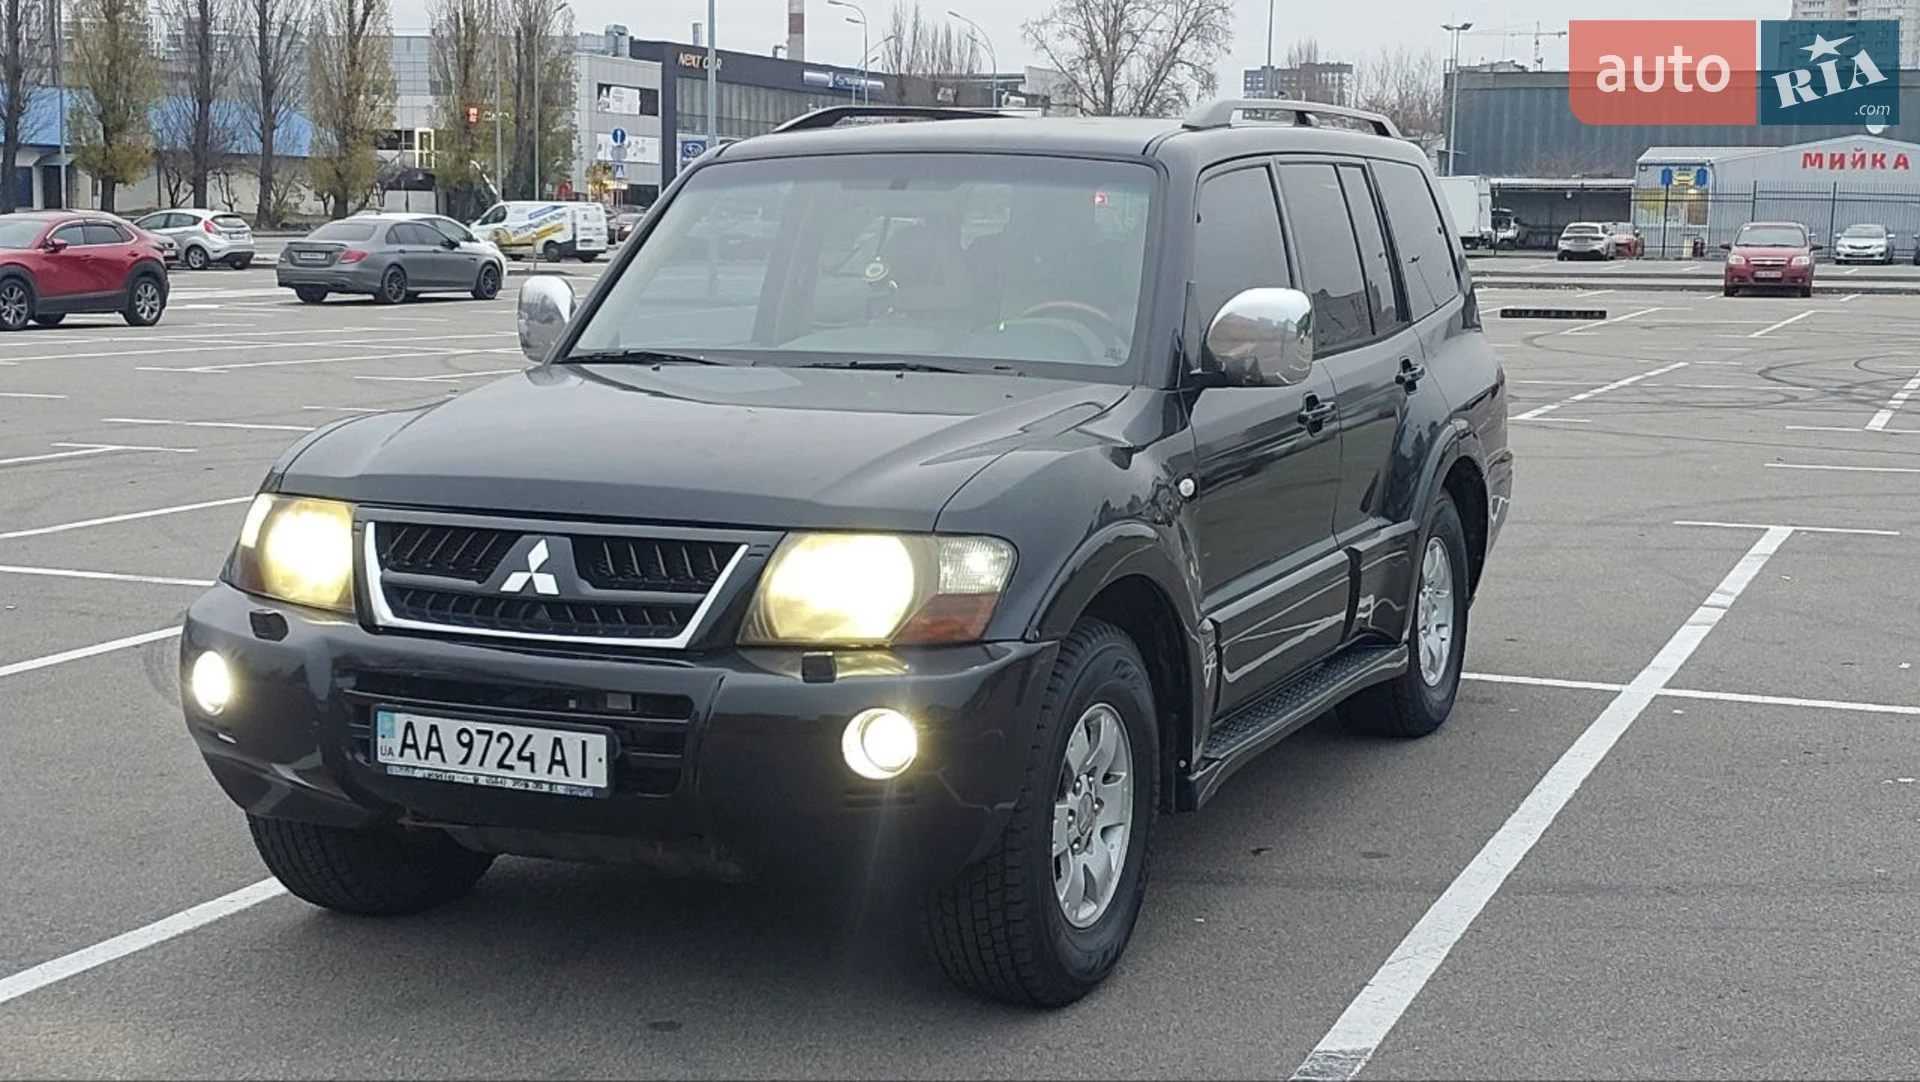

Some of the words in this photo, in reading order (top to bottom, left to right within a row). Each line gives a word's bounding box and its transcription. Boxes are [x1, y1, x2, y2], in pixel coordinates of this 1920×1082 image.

[702, 56, 722, 71] CR
[1802, 147, 1909, 170] МИЙКА
[380, 744, 395, 757] UA
[399, 721, 447, 763] AA
[456, 727, 536, 774] 9724
